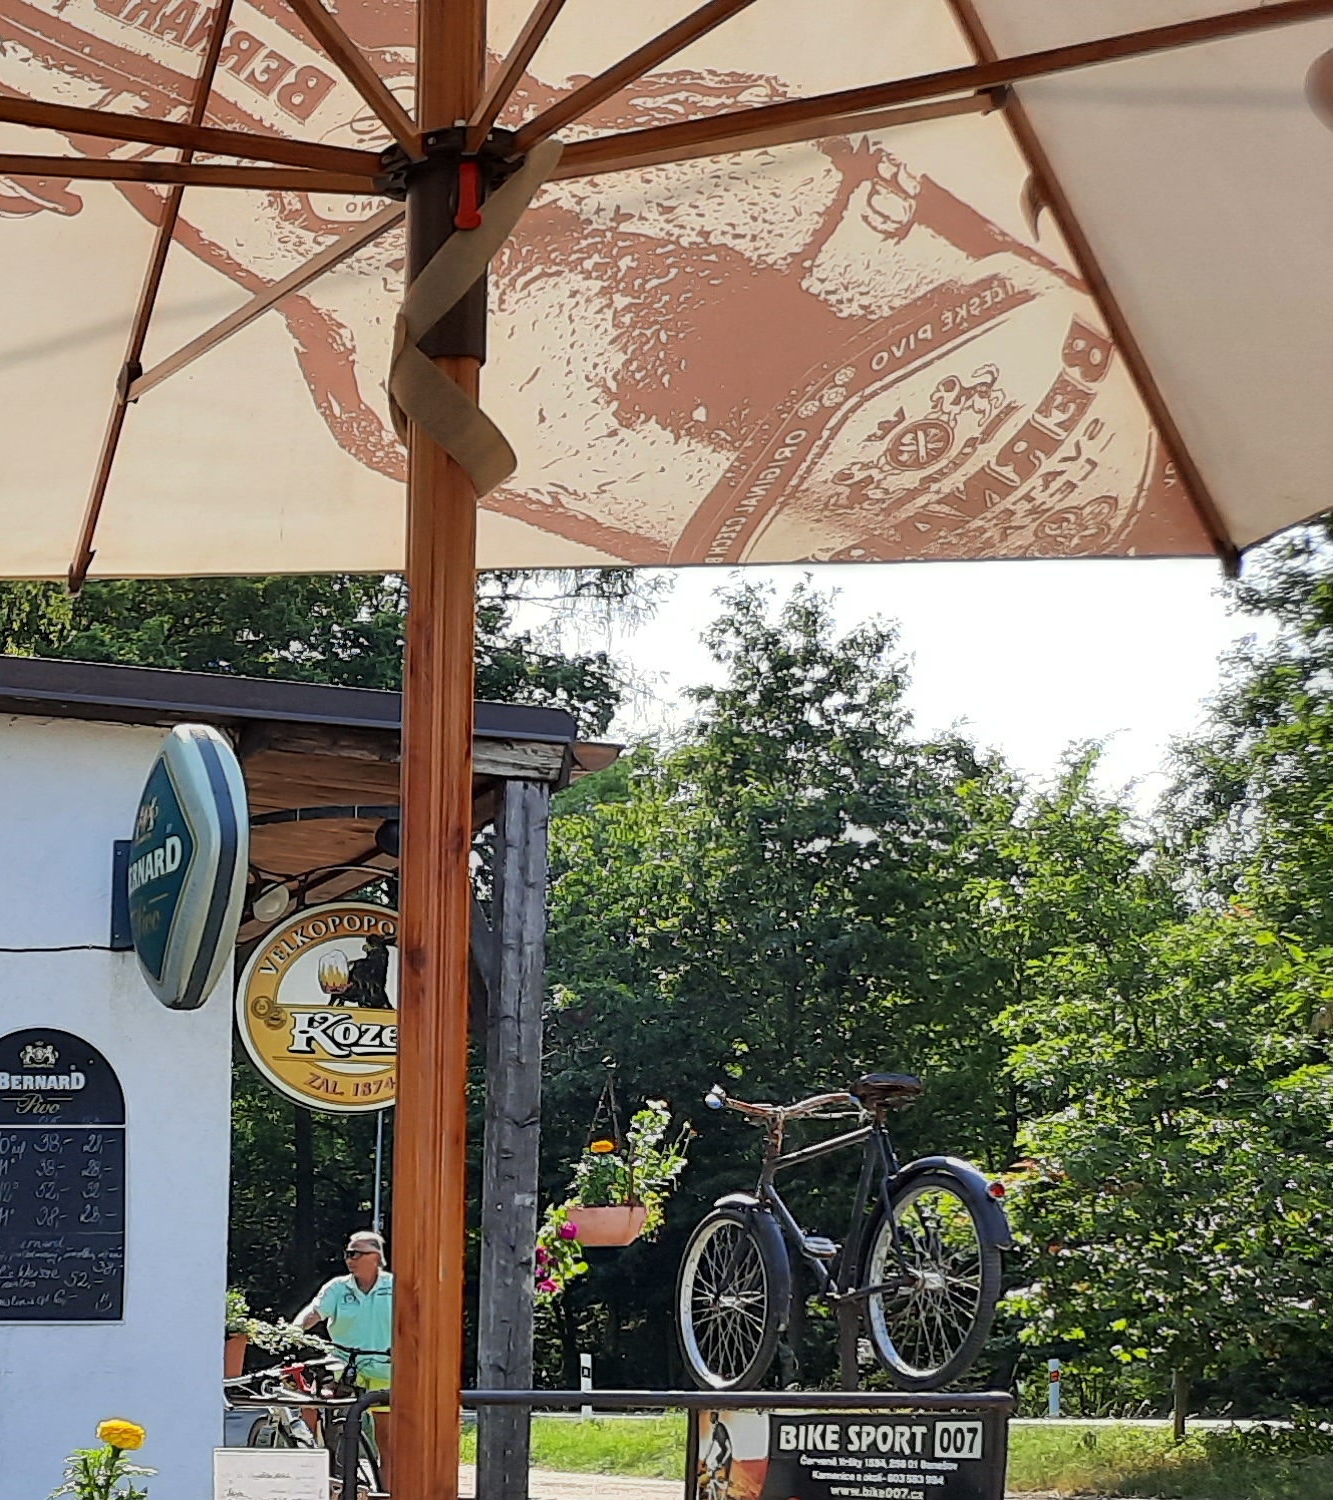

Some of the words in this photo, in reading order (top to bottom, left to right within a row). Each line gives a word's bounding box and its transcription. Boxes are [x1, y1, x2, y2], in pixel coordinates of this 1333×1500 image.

[257, 913, 397, 978] VELKOPOPO
[288, 1011, 397, 1057] Koze
[15, 1093, 62, 1114] Pivo
[779, 1425, 840, 1452] BIKE
[846, 1425, 928, 1456] SPORT
[940, 1427, 979, 1453] 007
[830, 1486, 925, 1500] www.bike007.cz
